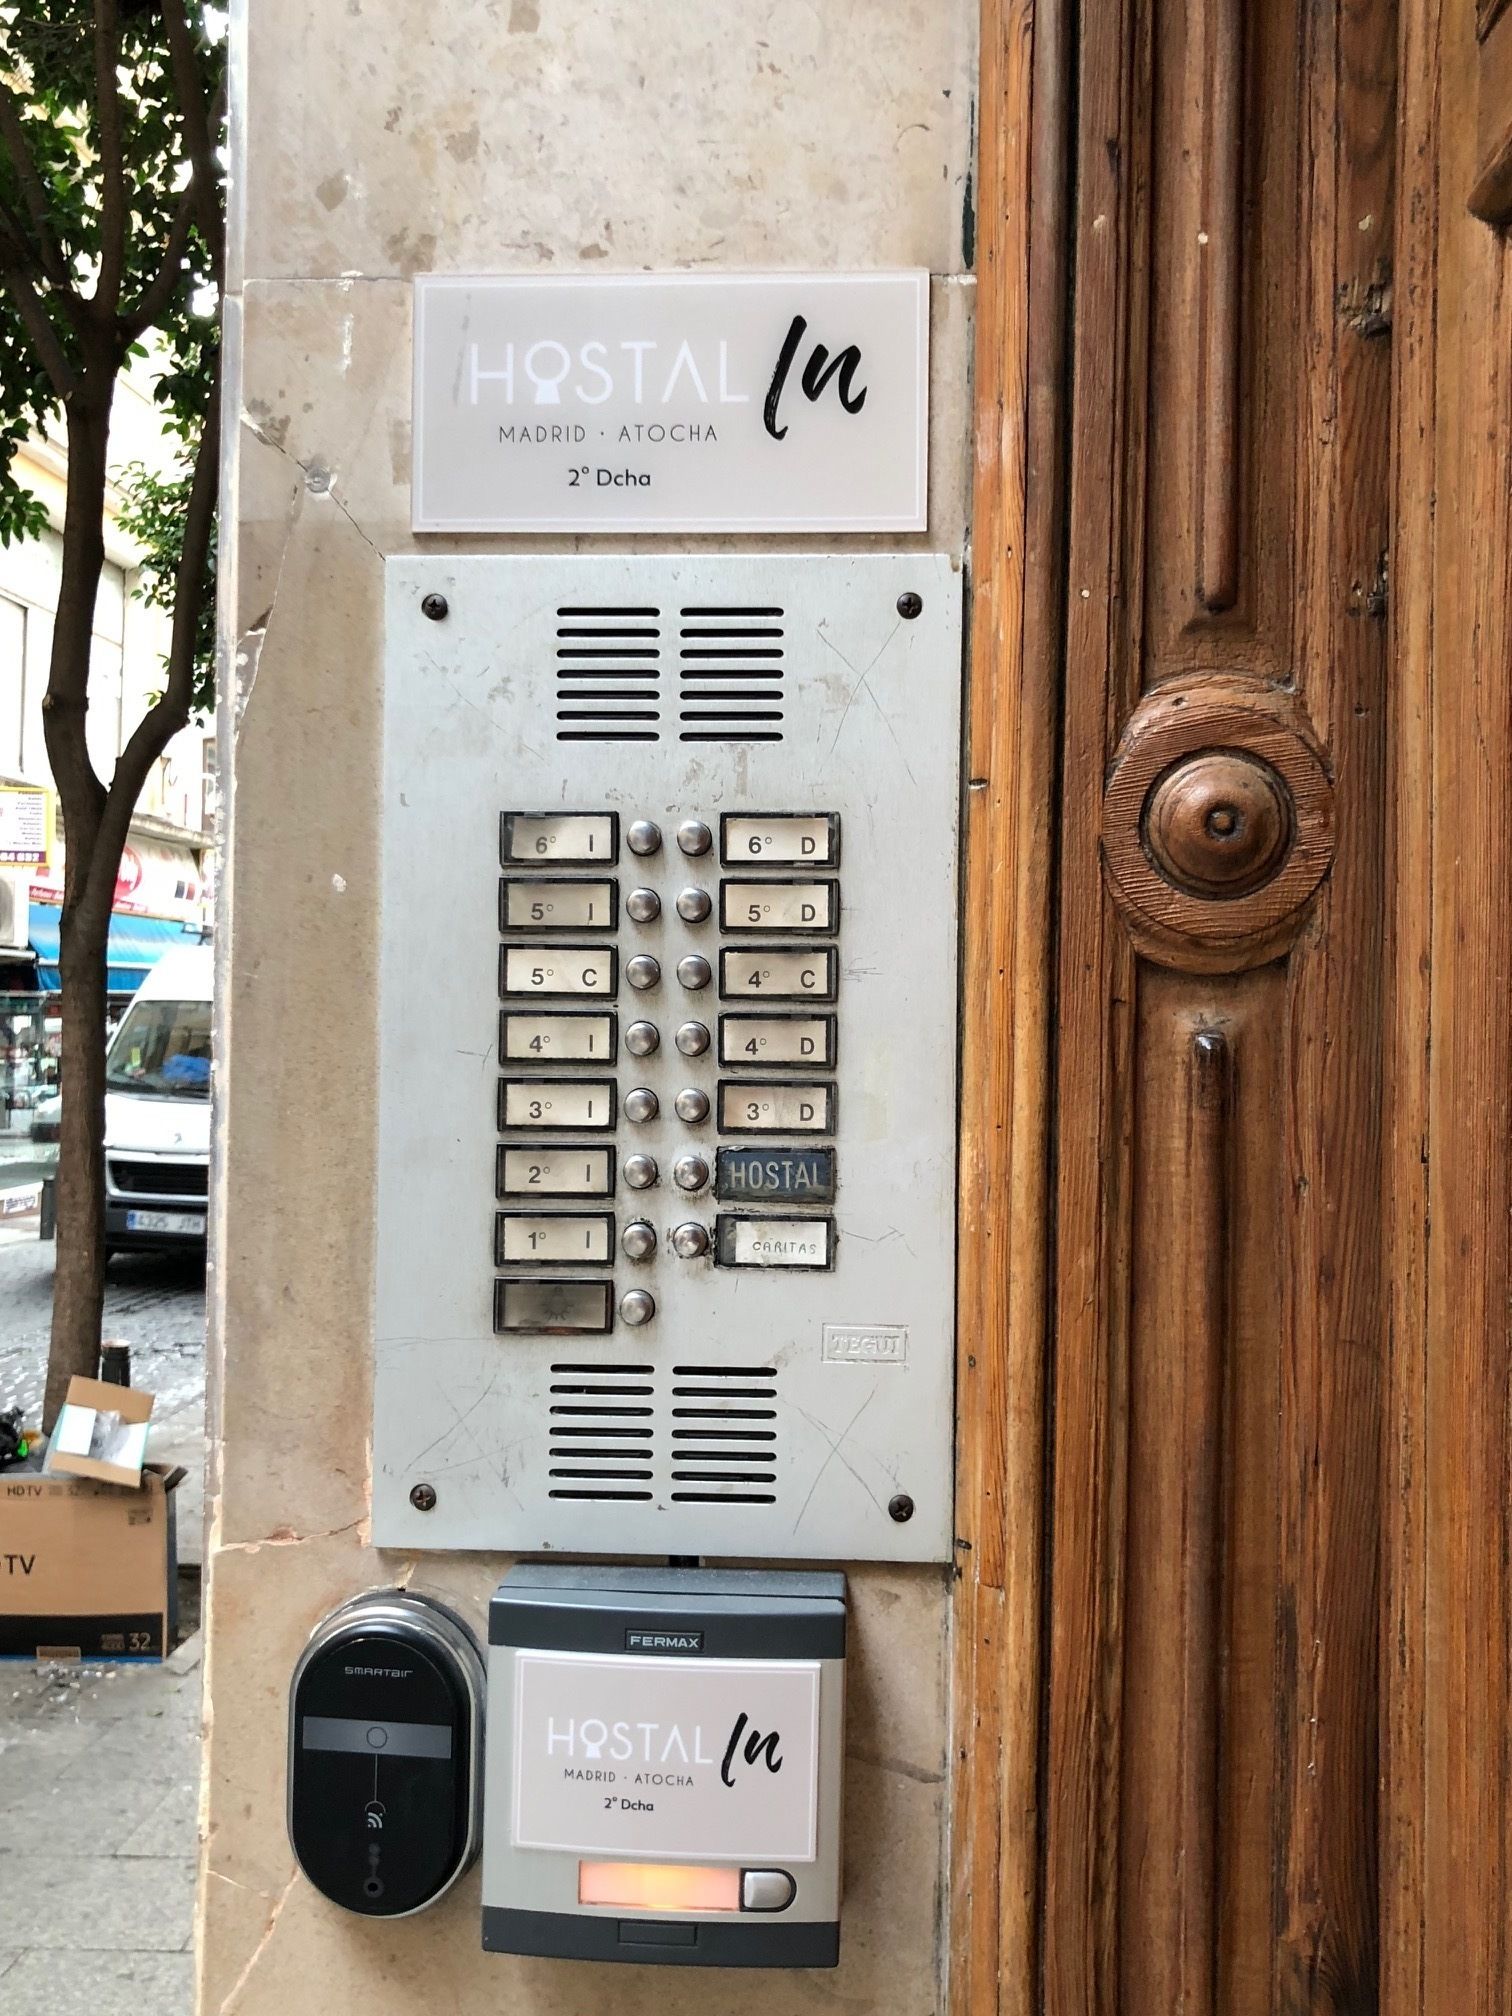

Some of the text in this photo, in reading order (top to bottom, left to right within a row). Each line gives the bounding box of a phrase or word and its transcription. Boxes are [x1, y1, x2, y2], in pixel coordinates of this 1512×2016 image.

[469, 339, 750, 405] HOSTAL
[499, 424, 718, 443] MADRID ATOCHA
[597, 468, 651, 487] Dcha
[801, 836, 816, 855] D
[801, 904, 816, 922] D
[581, 968, 598, 987] C
[800, 969, 816, 988] C
[800, 1036, 815, 1055] D
[799, 1103, 815, 1121] D
[730, 1160, 824, 1191] HOSTAL
[752, 1240, 818, 1256] CARITAS
[128, 1632, 151, 1650] 32
[630, 1635, 699, 1648] FERMAX
[547, 1716, 714, 1764] HOSTAL
[564, 1768, 694, 1787] MADRID ATOCHA
[621, 1798, 654, 1812] Dcha
